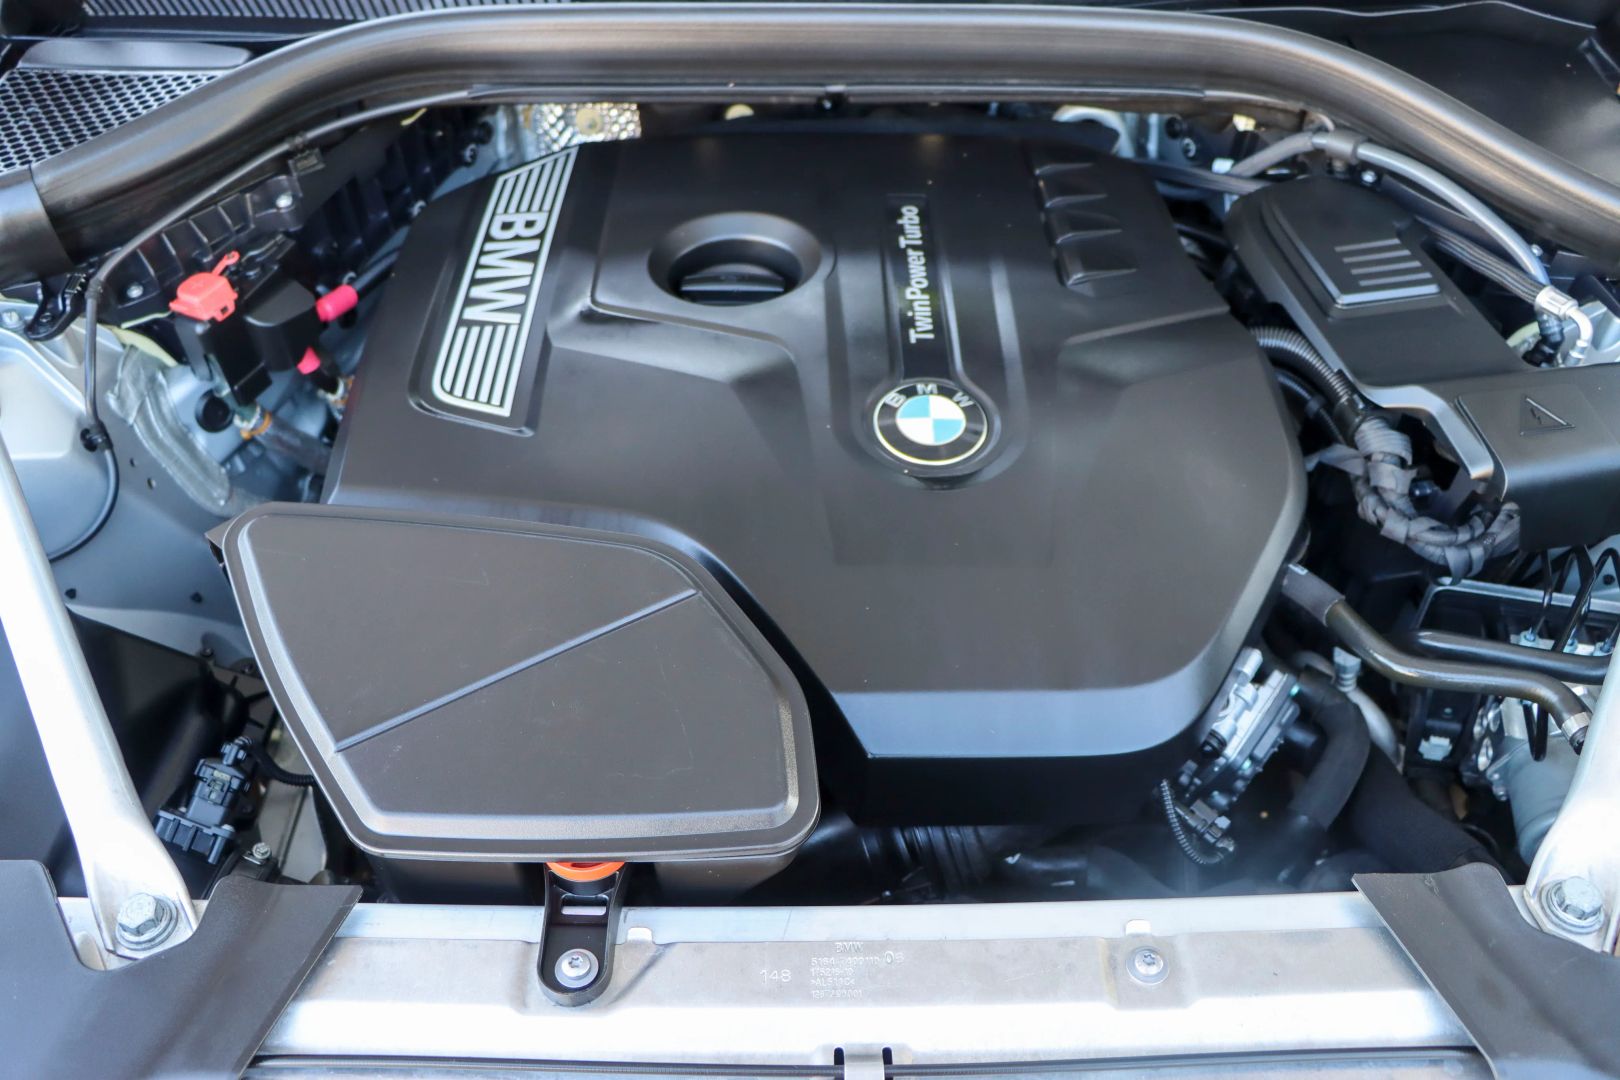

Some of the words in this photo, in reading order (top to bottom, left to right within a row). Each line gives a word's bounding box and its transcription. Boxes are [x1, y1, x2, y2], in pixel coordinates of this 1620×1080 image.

[896, 205, 923, 249] Turbo
[462, 211, 550, 325] BMW
[905, 248, 935, 344] TwinPower
[884, 383, 975, 408] BMW
[834, 941, 864, 953] BMW
[760, 969, 792, 984] 148
